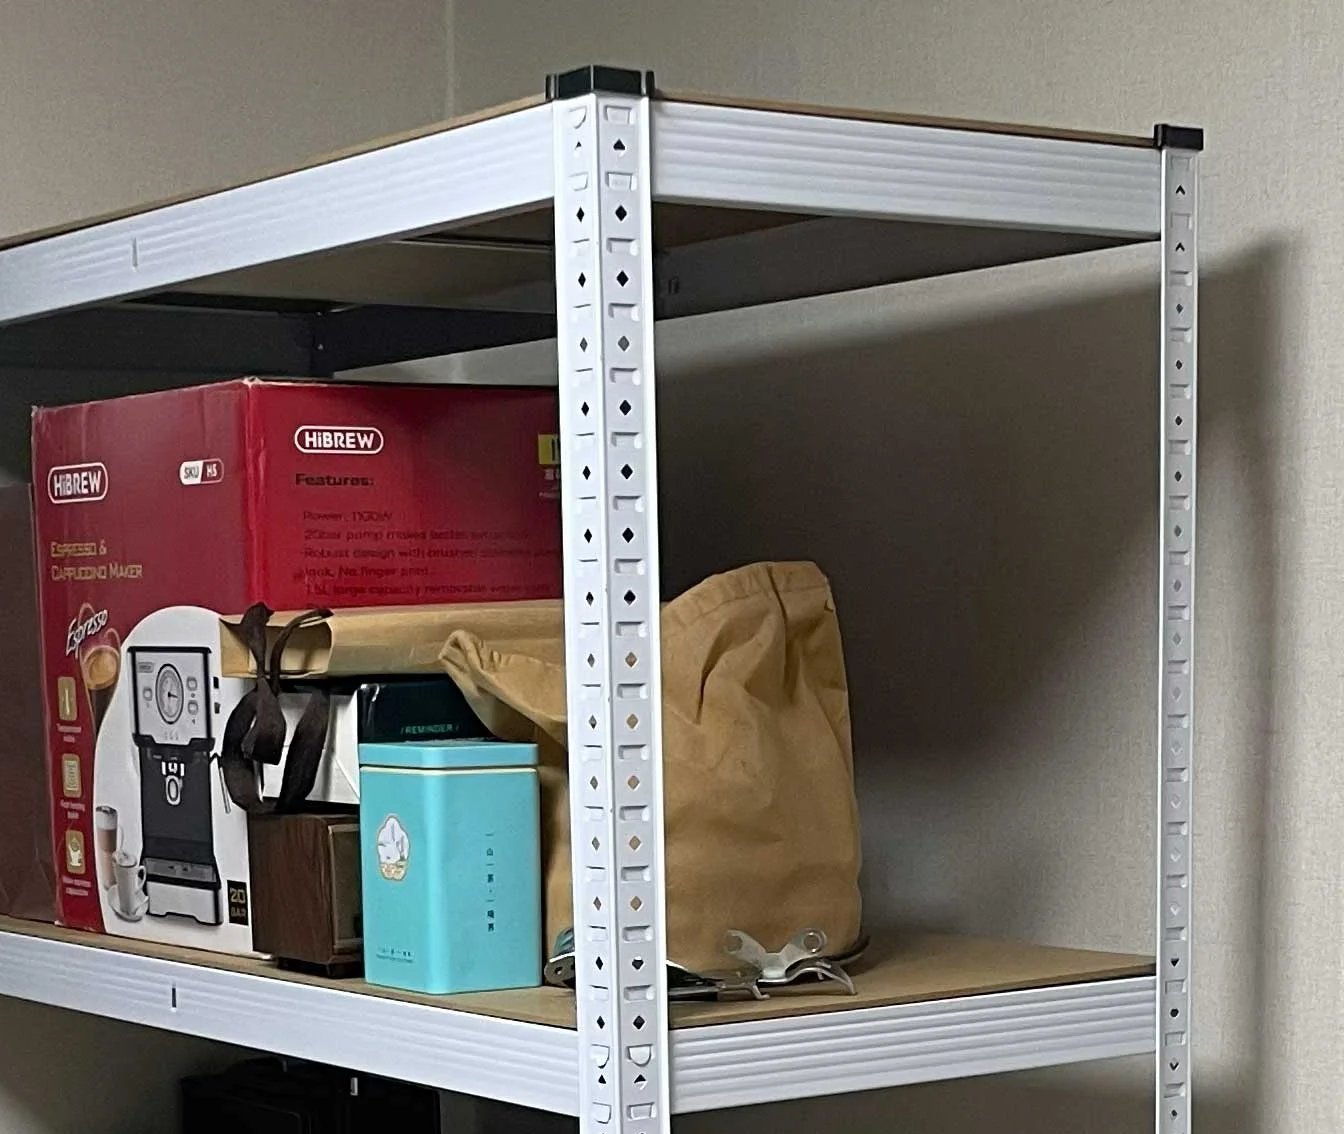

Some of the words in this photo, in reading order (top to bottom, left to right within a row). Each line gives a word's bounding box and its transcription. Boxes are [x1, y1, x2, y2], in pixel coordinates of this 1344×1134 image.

[304, 431, 375, 449] HiBREW
[53, 469, 102, 497] HiBREW
[295, 473, 374, 487] Features:
[65, 609, 109, 661] Espresso
[229, 889, 246, 905] 20
